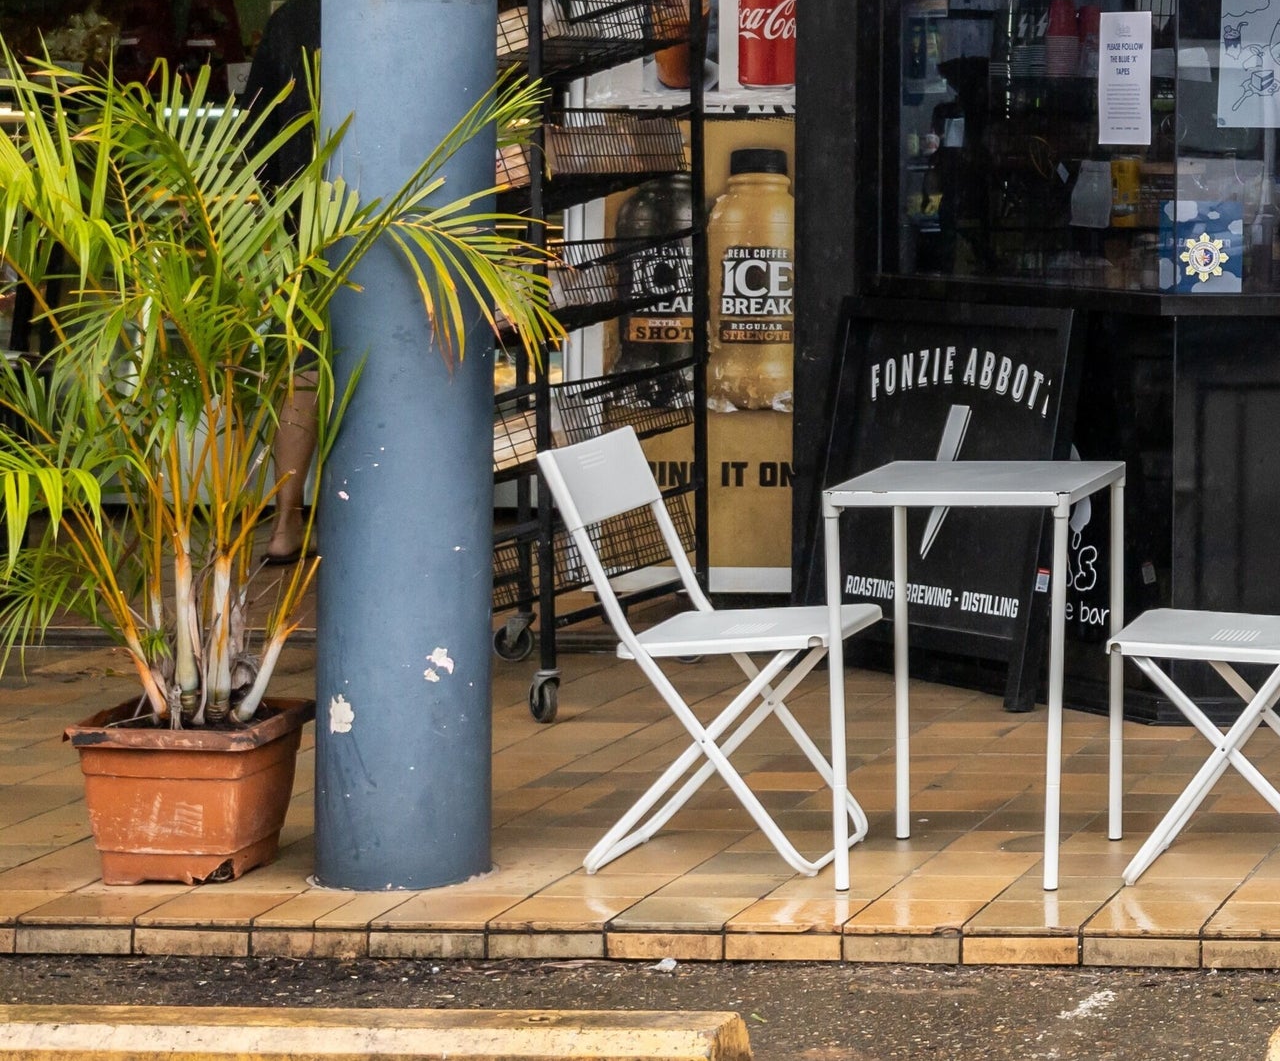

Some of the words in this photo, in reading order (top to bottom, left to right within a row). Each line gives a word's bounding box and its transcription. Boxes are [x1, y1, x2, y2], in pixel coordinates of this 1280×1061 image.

[1106, 43, 1121, 51] PLEASE
[1121, 42, 1144, 51] FOLLOW
[1110, 55, 1118, 63] THE
[1118, 55, 1130, 63] BLUE
[1115, 67, 1130, 76] TAPES
[727, 248, 750, 259] REAL
[753, 248, 788, 259] COFFEE
[722, 259, 792, 298] ICE
[721, 297, 793, 315] BREAK
[636, 326, 694, 339] SHOT
[731, 322, 783, 331] REGULAR
[722, 330, 791, 342] STRENGTH
[870, 345, 957, 402] FONZIE
[962, 347, 1052, 419] ABBOT
[721, 461, 749, 487] IT
[759, 461, 794, 487] ON
[845, 574, 896, 601] ROASTING
[960, 591, 1020, 619] DISTILLING
[1079, 602, 1111, 626] bar
